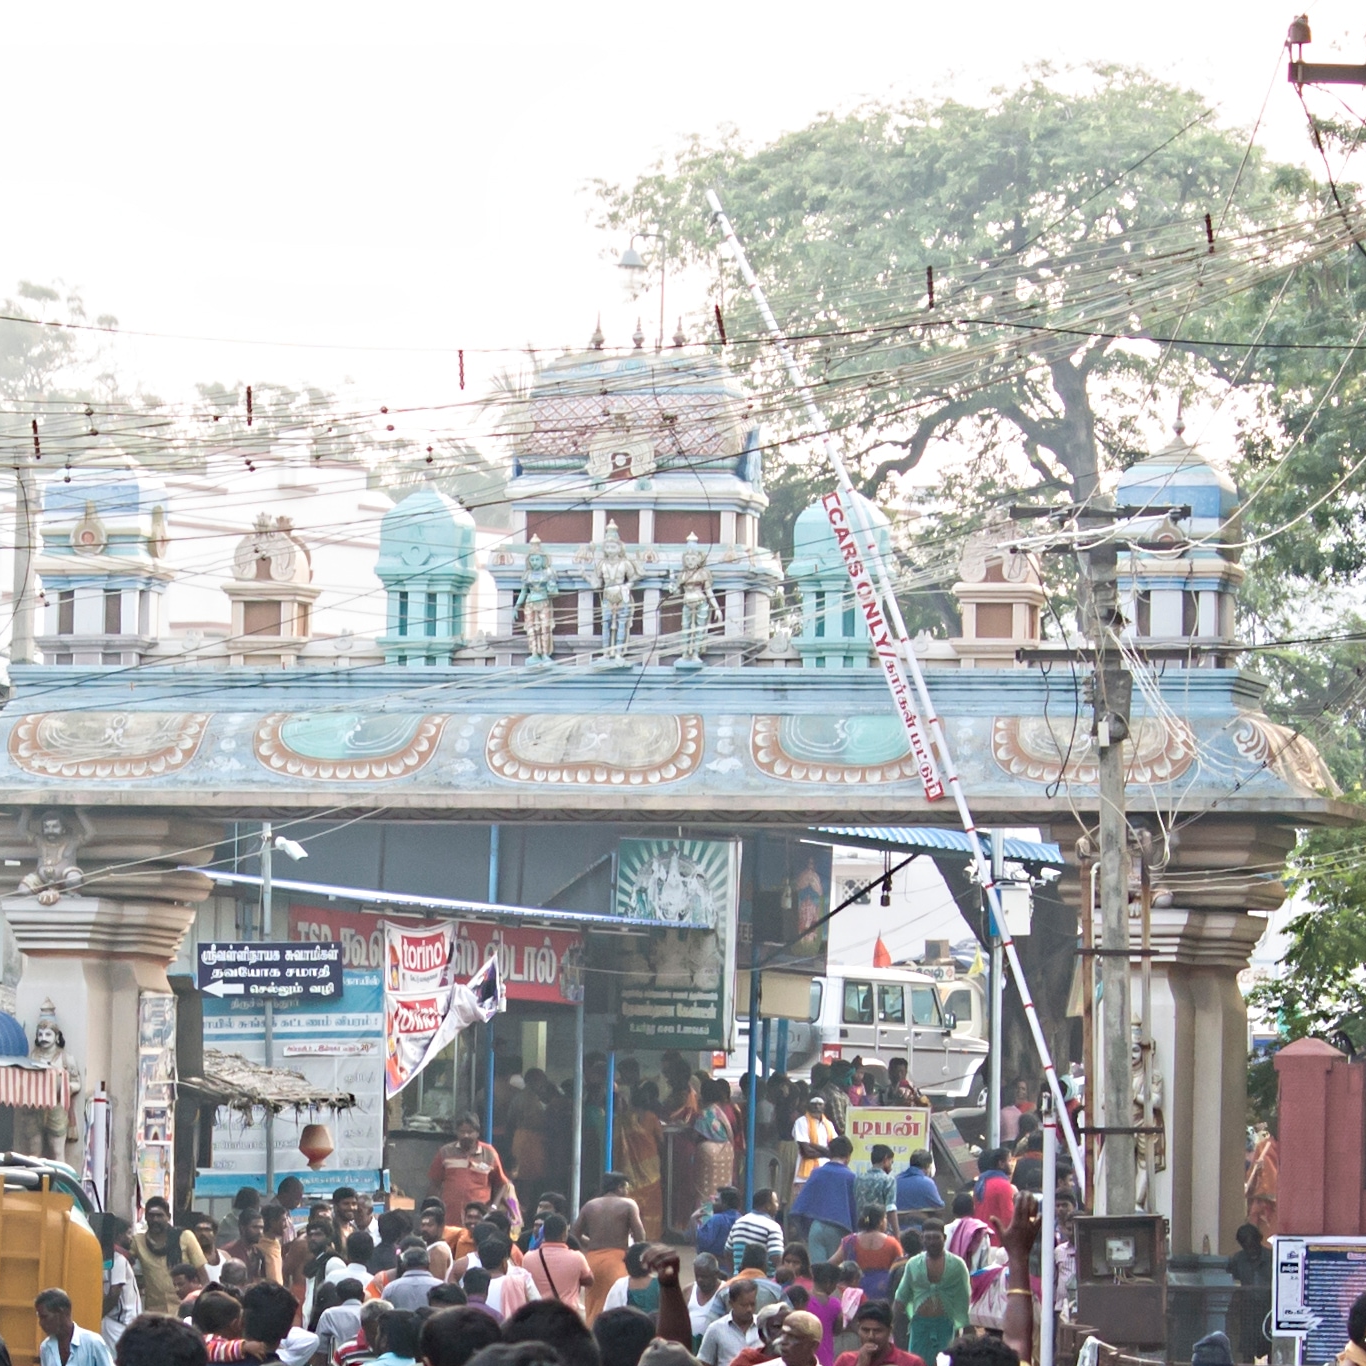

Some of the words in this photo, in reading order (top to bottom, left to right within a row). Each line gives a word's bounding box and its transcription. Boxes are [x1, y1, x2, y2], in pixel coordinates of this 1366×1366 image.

[829, 509, 864, 578] CARS
[403, 938, 442, 970] torino
[285, 965, 330, 979] சமாதி
[309, 982, 335, 996] வழி
[853, 1115, 922, 1138] டிபன்
